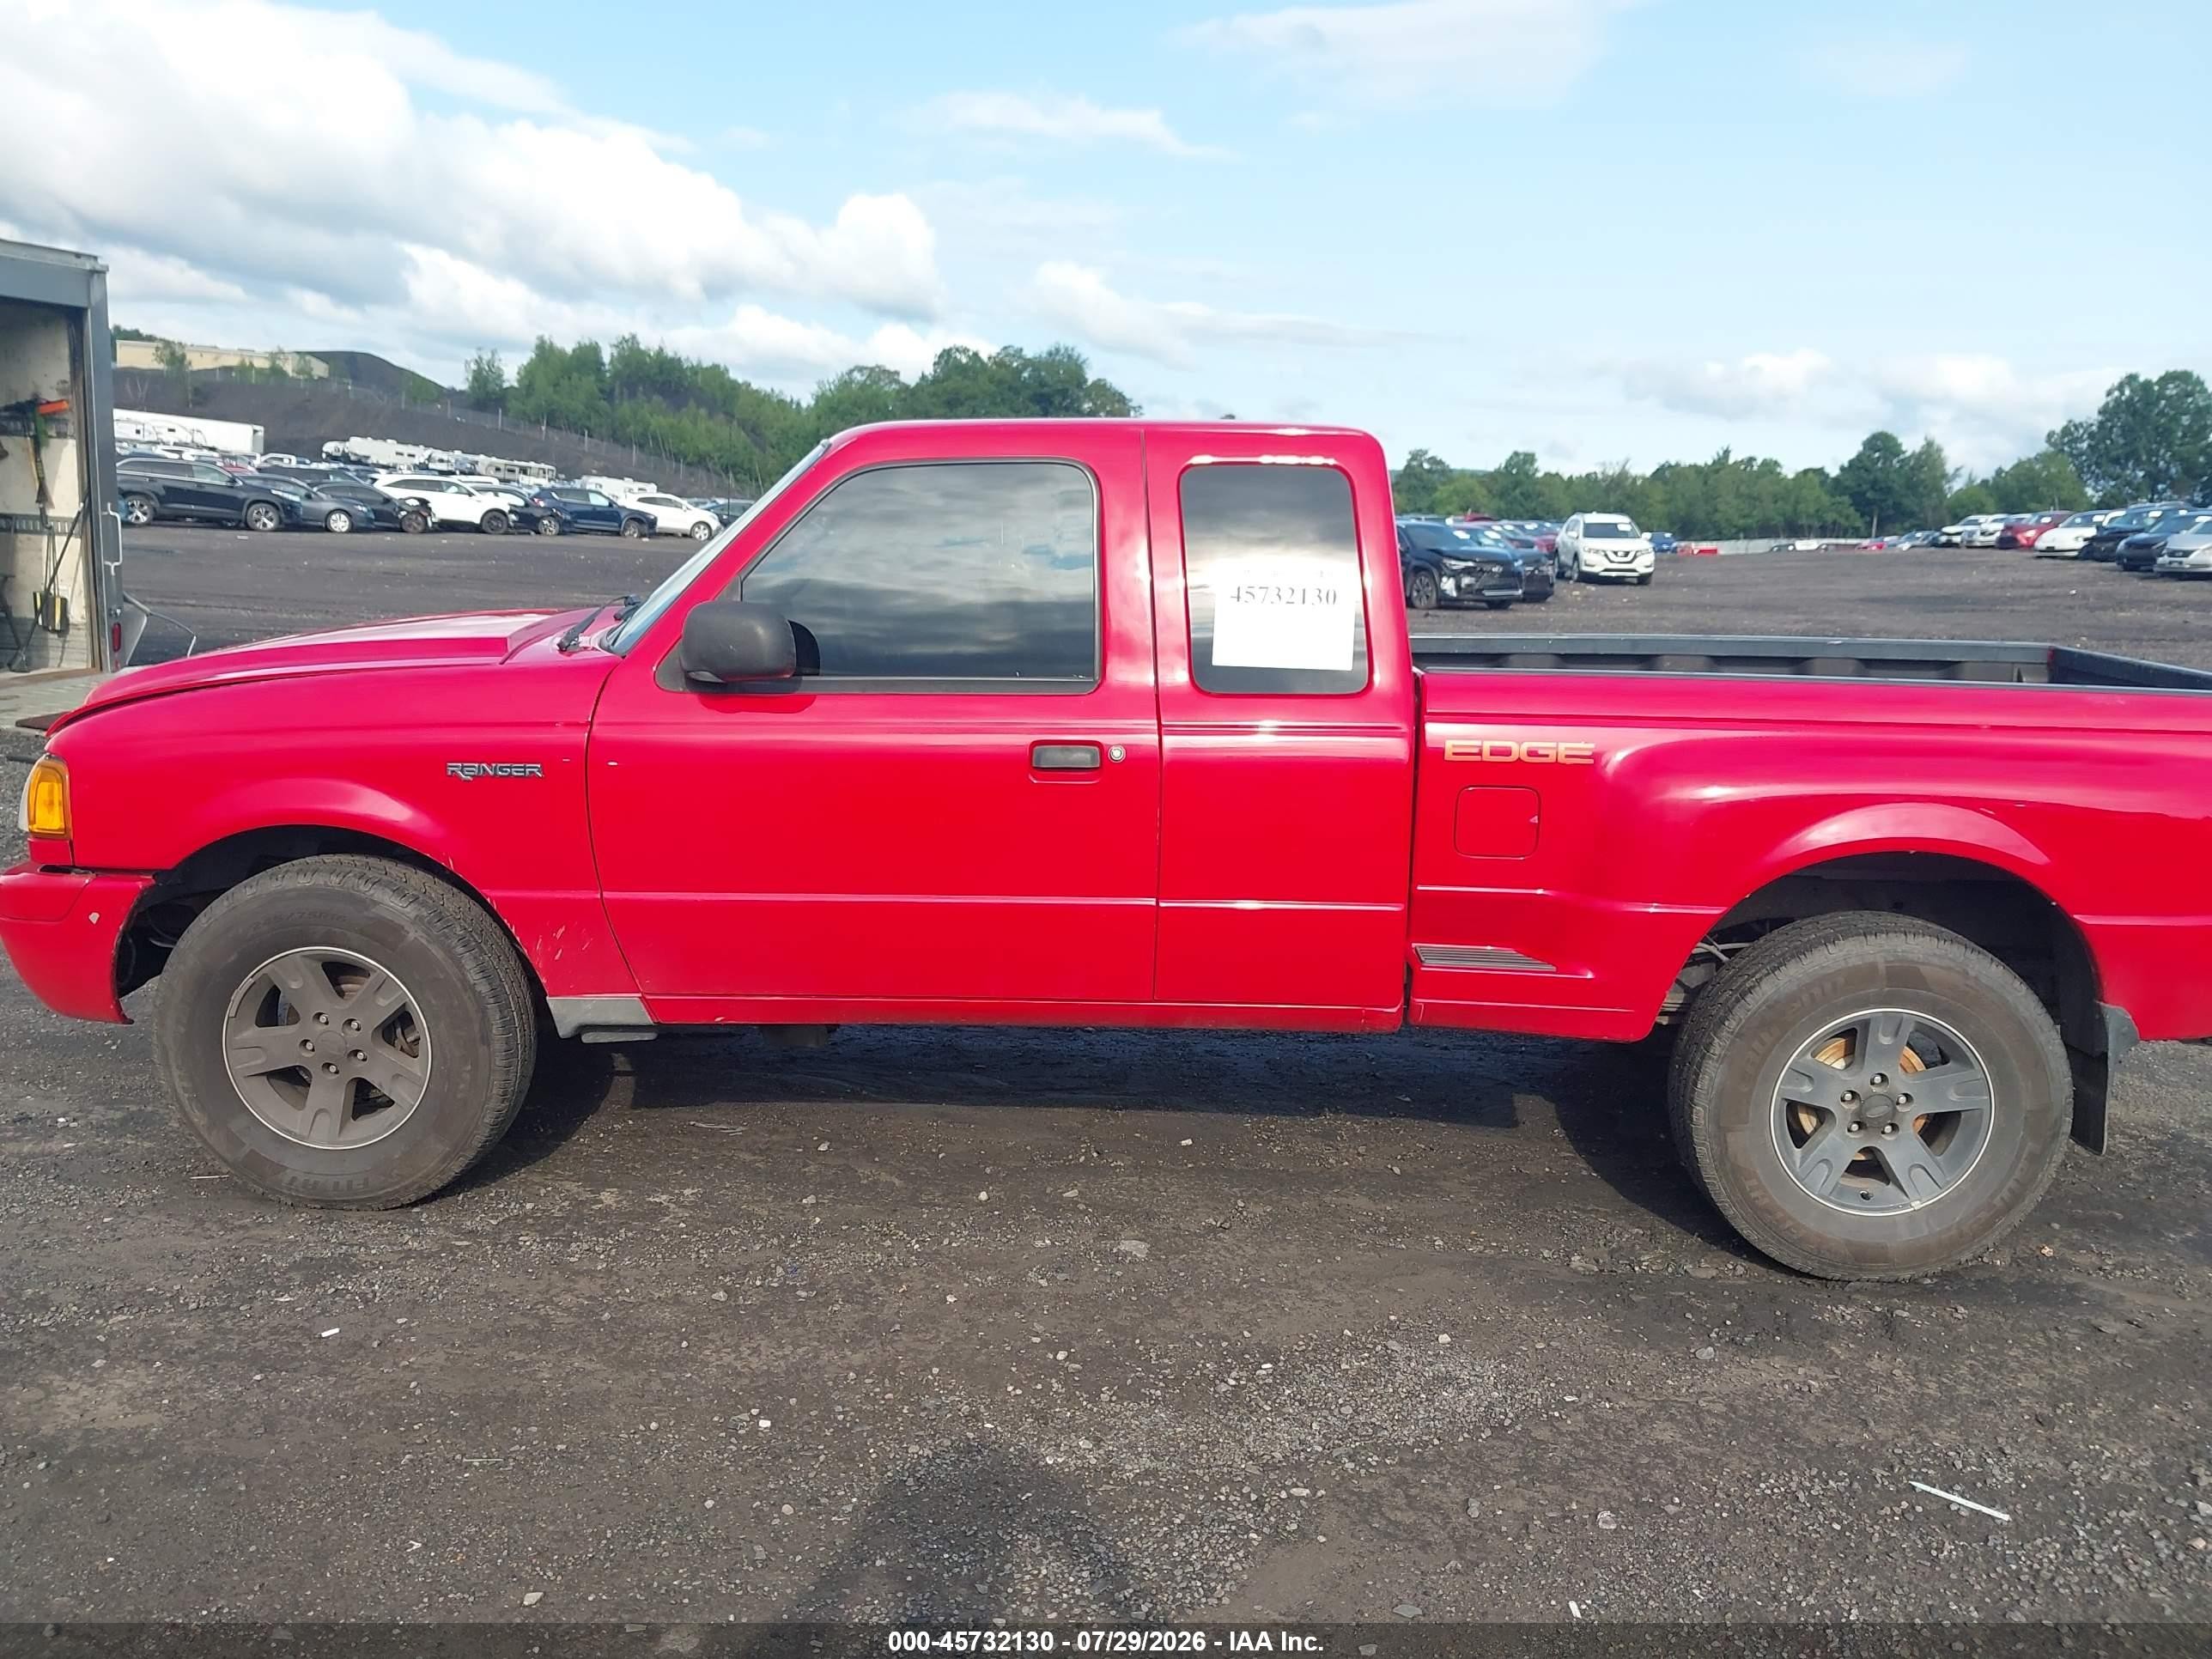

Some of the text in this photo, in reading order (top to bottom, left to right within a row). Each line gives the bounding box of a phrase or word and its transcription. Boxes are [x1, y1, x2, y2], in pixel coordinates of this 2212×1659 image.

[1230, 586, 1337, 605] 45732130
[1444, 739, 1595, 764] EDGE
[446, 763, 543, 781] RANGER
